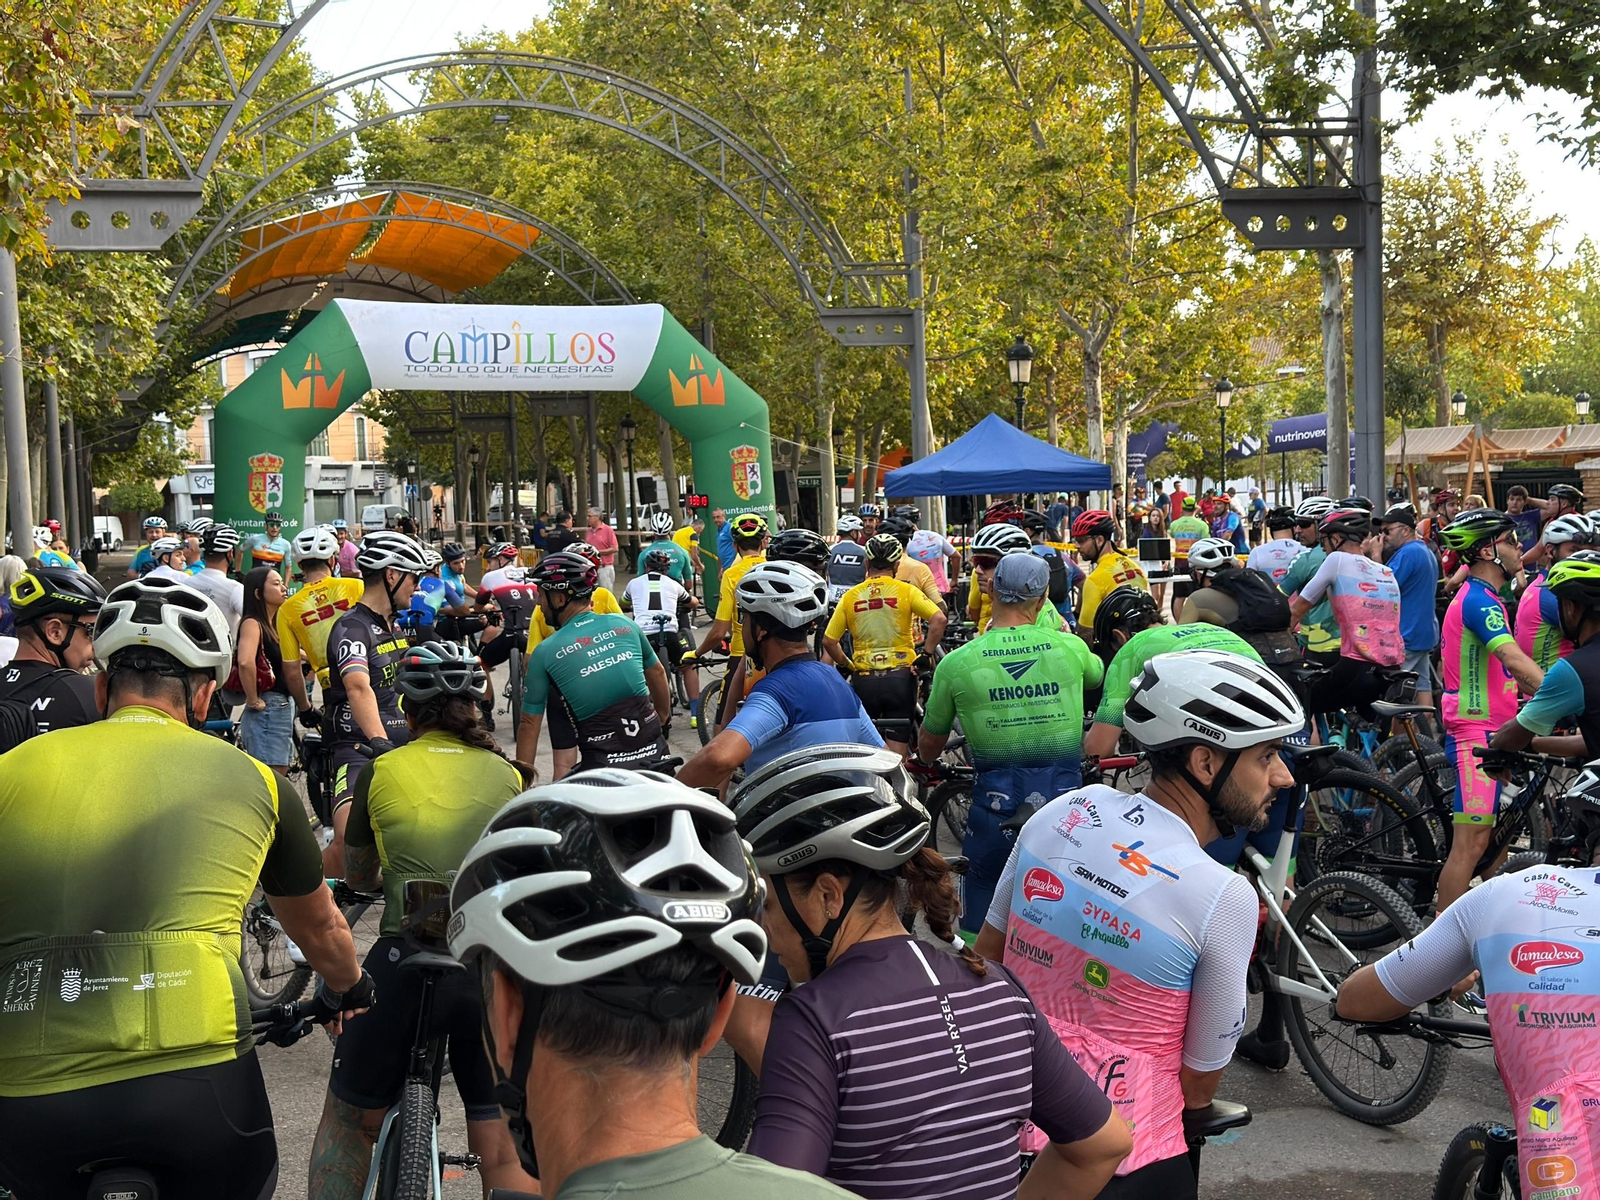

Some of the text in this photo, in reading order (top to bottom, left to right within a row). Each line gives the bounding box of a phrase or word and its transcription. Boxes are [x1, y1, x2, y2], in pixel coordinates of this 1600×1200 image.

[404, 330, 616, 365] CAMPILLOS
[404, 365, 452, 373] TODO
[524, 365, 615, 373] NECESITAS
[1275, 428, 1326, 443] nutrinovex
[797, 478, 821, 486] SUR
[290, 519, 298, 527] de
[833, 554, 862, 566] NCL
[50, 592, 87, 605] SCOTT
[587, 642, 616, 658] NIMO
[982, 643, 1052, 657] SERRABIKE MTB
[579, 650, 634, 678] SALESLAND
[988, 682, 1060, 701] KENOGARD
[1189, 721, 1222, 740] ABUS
[608, 749, 658, 764] TRAINING
[782, 847, 813, 864] ABUS
[1023, 869, 1063, 897] famadesa
[1074, 865, 1094, 882] SAN
[1094, 875, 1130, 898] MOTOS
[1310, 883, 1346, 899] MAXXIS
[673, 905, 726, 918] ABUS
[1022, 908, 1043, 925] Calidad
[1082, 901, 1142, 942] GYPASA
[1090, 927, 1130, 950] Arquillo
[1016, 937, 1054, 964] TRIVIUM
[1514, 944, 1581, 966] famadesa
[83, 976, 129, 984] Ayuntamiento
[157, 969, 192, 979] Diputación
[29, 972, 42, 1003] WINES
[92, 984, 109, 992] Jerez
[157, 977, 187, 988] de Cádiz
[1072, 981, 1089, 995] JOHN
[1528, 982, 1566, 991] Calidad
[2, 1001, 36, 1013] SHERRY
[1530, 1012, 1596, 1024] TRIVIUM
[940, 995, 969, 1075] VAN RYSEL
[1530, 1186, 1581, 1200] campano
